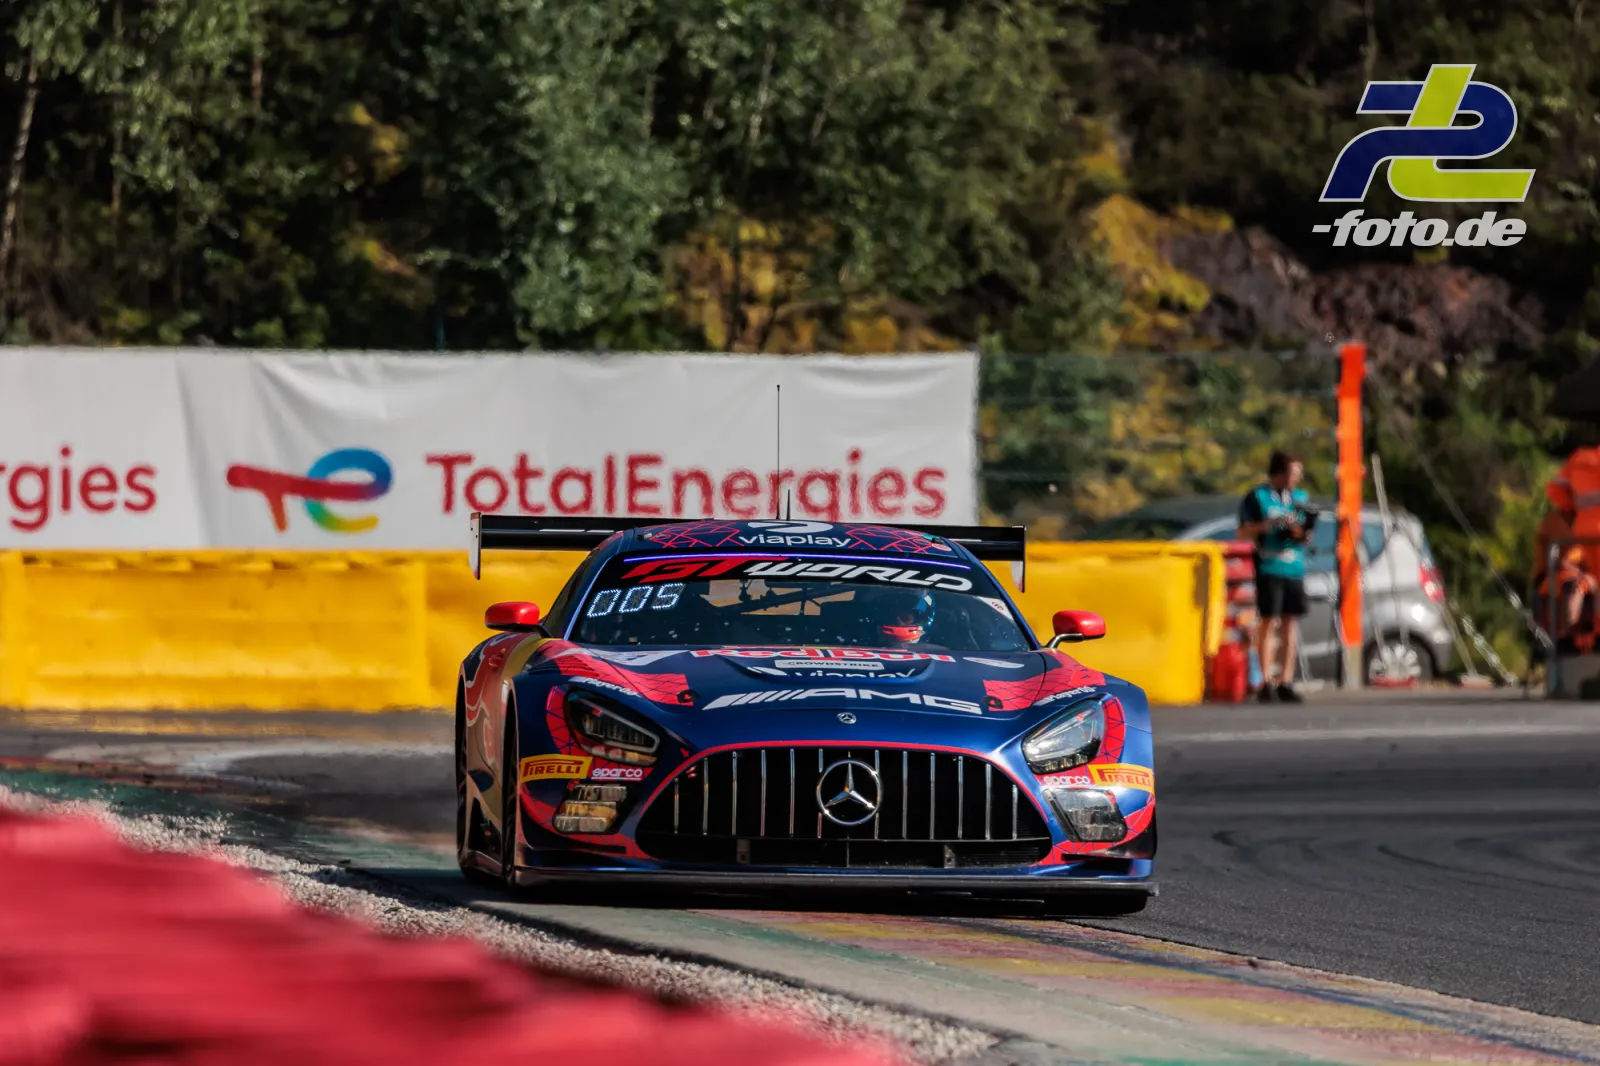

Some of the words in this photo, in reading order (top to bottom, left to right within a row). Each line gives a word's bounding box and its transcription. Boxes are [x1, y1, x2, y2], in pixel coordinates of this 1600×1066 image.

[0, 445, 158, 532] gies
[425, 448, 947, 522] TotalEnergies
[739, 534, 852, 548] viaplay
[743, 562, 973, 591] WORLD
[587, 582, 685, 617] 005
[792, 687, 983, 715] AMG
[523, 758, 585, 777] PIRELLI
[592, 767, 643, 778] sparco
[1096, 768, 1152, 787] PIRELLI
[1043, 775, 1090, 785] sparco
